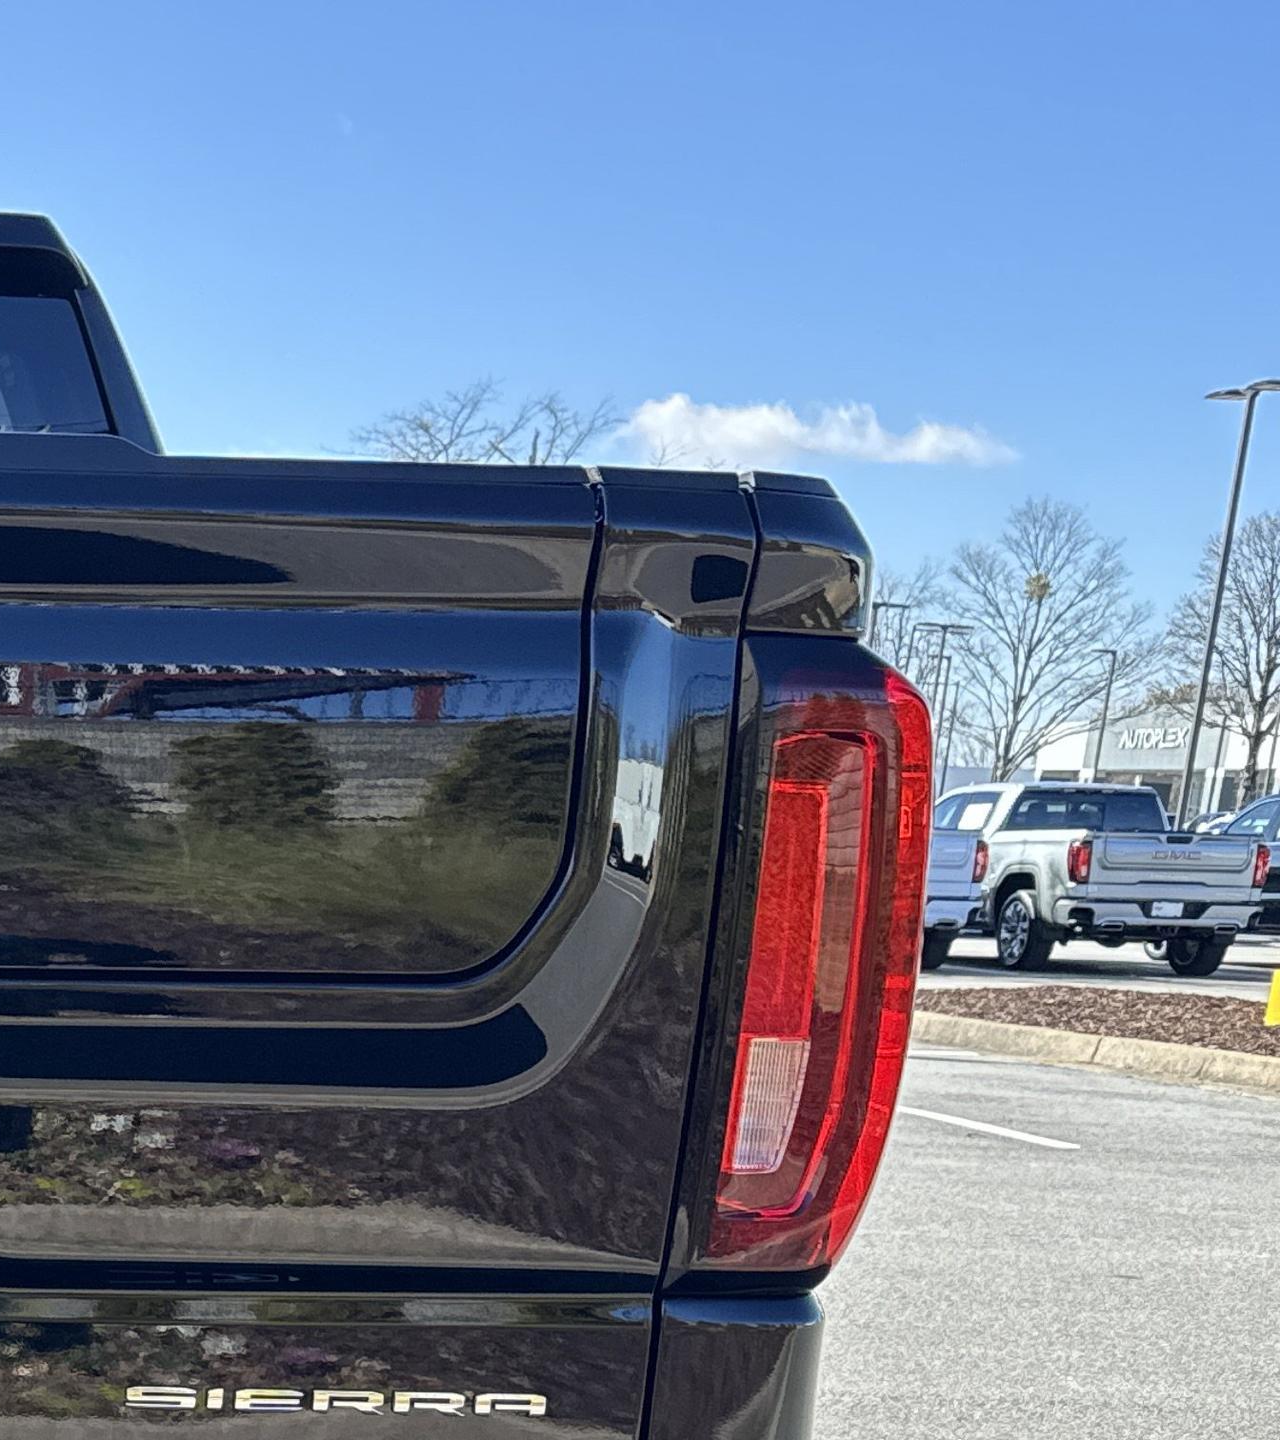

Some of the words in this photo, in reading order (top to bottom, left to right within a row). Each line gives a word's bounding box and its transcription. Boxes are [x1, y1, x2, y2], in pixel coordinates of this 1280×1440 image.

[1119, 727, 1189, 749] AUTOPLEX
[1152, 850, 1202, 861] GMC
[125, 1386, 547, 1417] SIERRA
